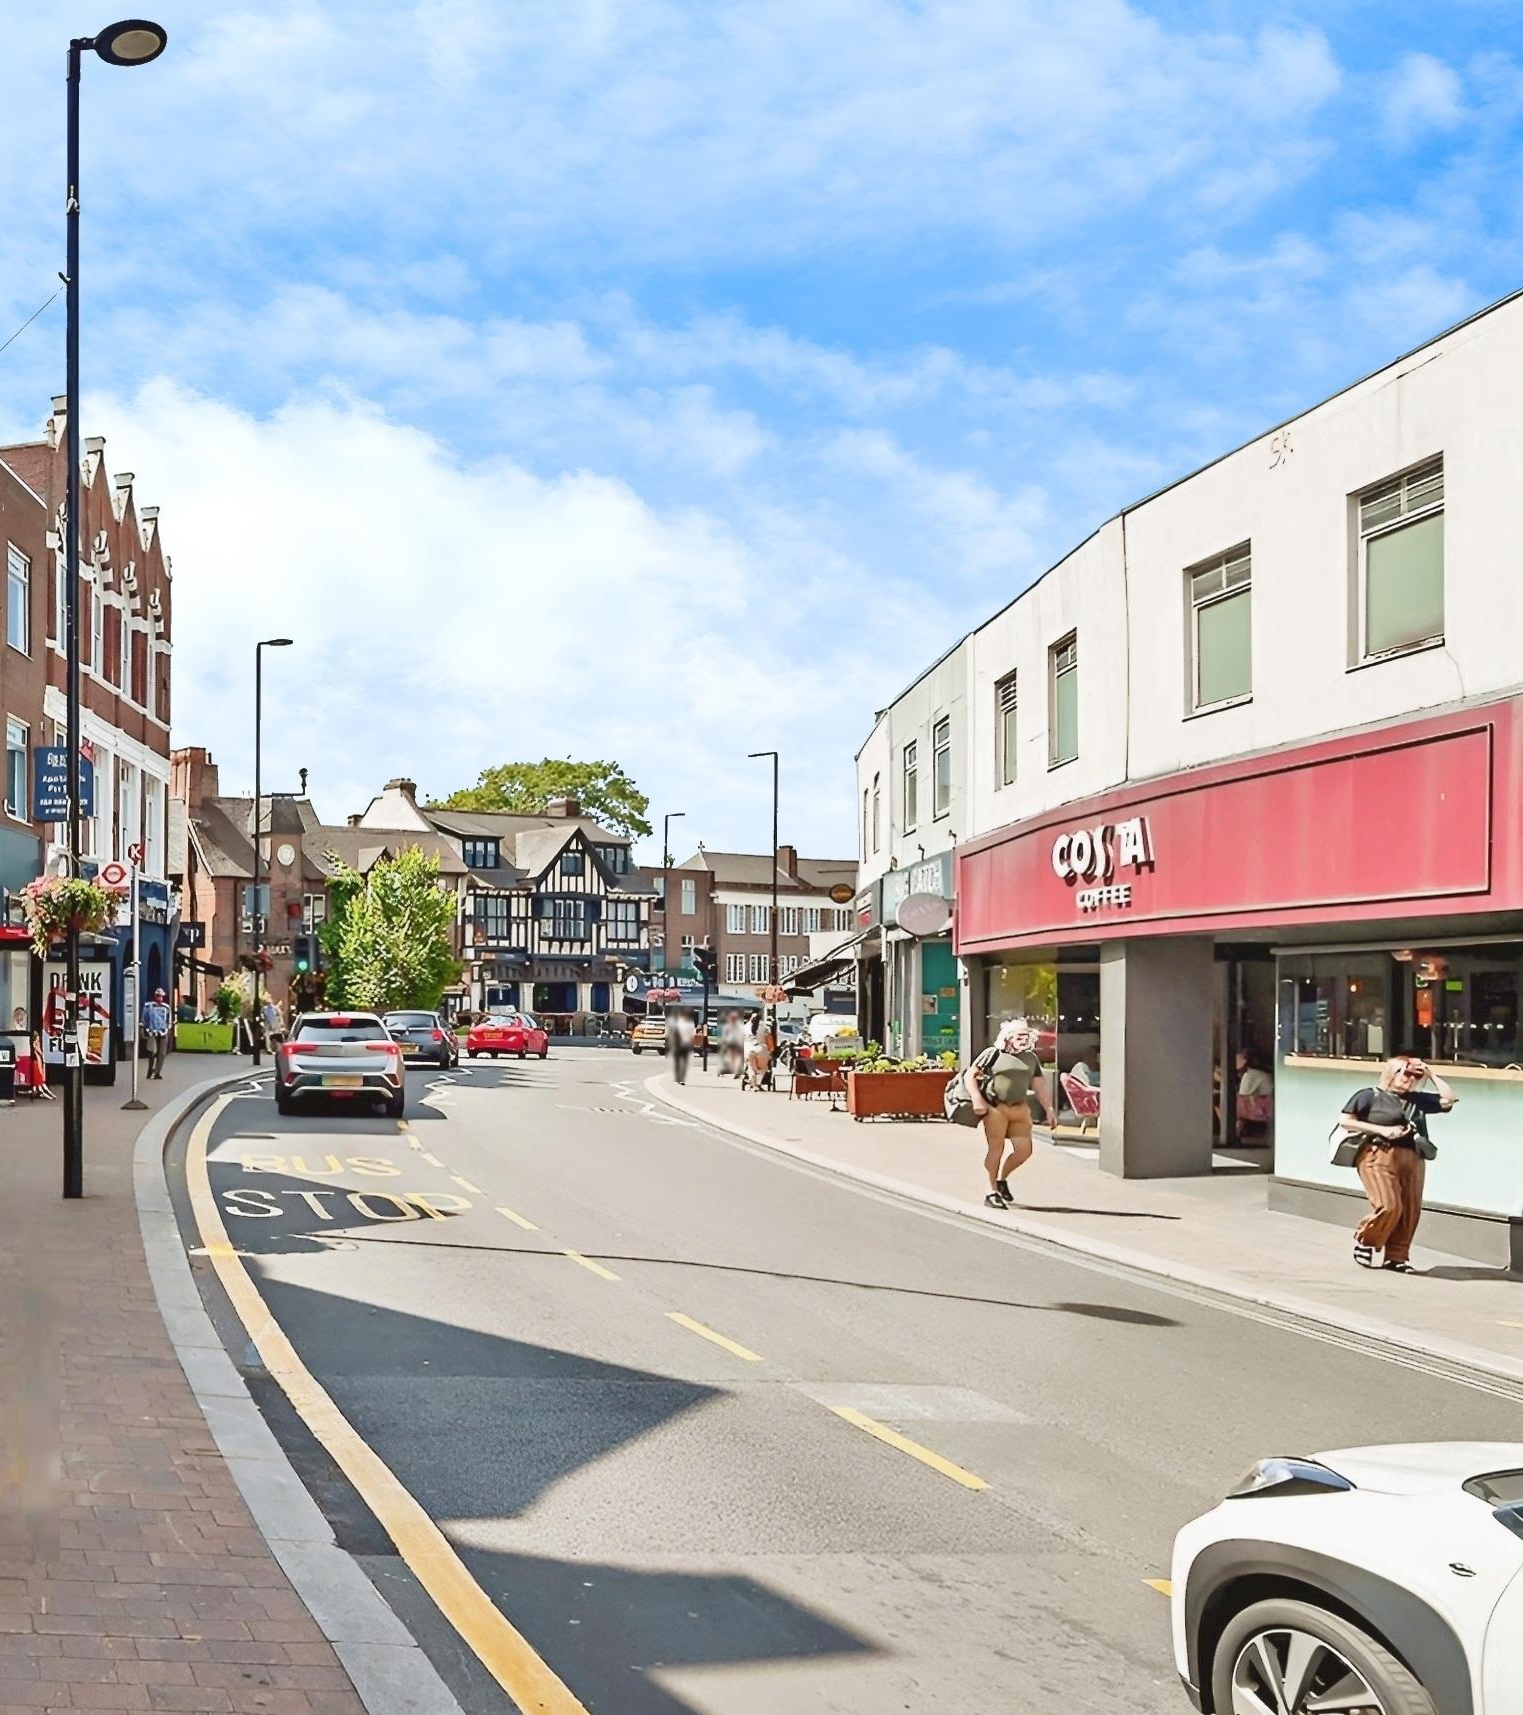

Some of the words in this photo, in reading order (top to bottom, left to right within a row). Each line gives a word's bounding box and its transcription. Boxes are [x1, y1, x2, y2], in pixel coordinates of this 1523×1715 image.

[1051, 816, 1155, 880] COSTA
[241, 1153, 402, 1177] BUS
[222, 1189, 473, 1222] STOP
